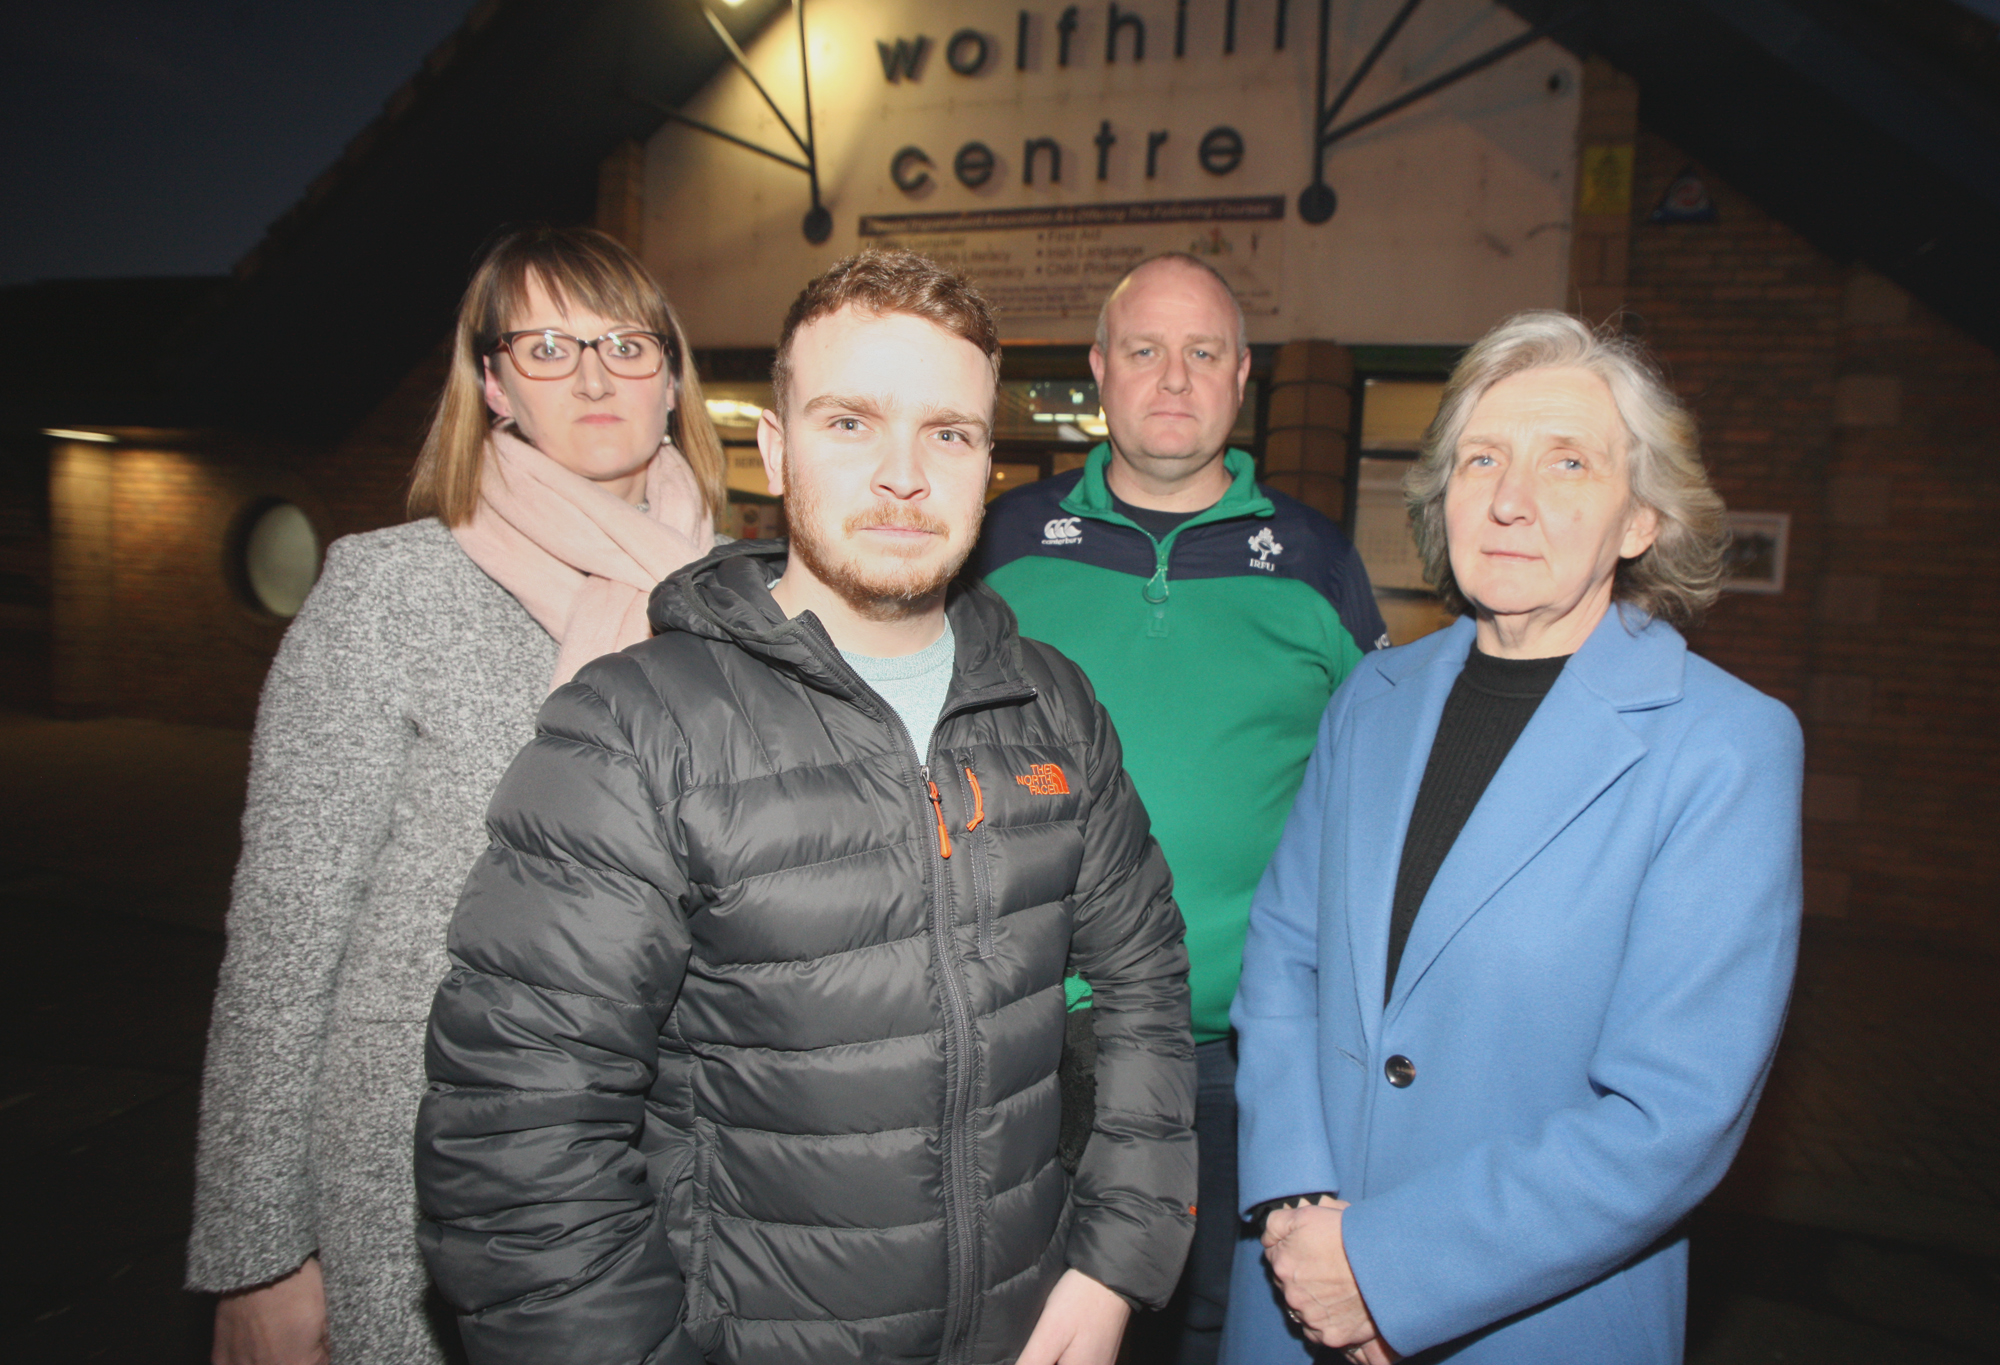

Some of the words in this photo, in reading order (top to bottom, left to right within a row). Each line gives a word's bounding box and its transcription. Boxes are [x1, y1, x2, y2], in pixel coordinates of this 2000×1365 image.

[876, 0, 1288, 85] wolfhill
[890, 121, 1244, 193] centre
[1040, 537, 1083, 546] canterbury
[1249, 557, 1276, 572] IRFU
[1029, 763, 1053, 775] THE
[1015, 774, 1052, 786] NORTH
[1028, 784, 1056, 796] FACE
